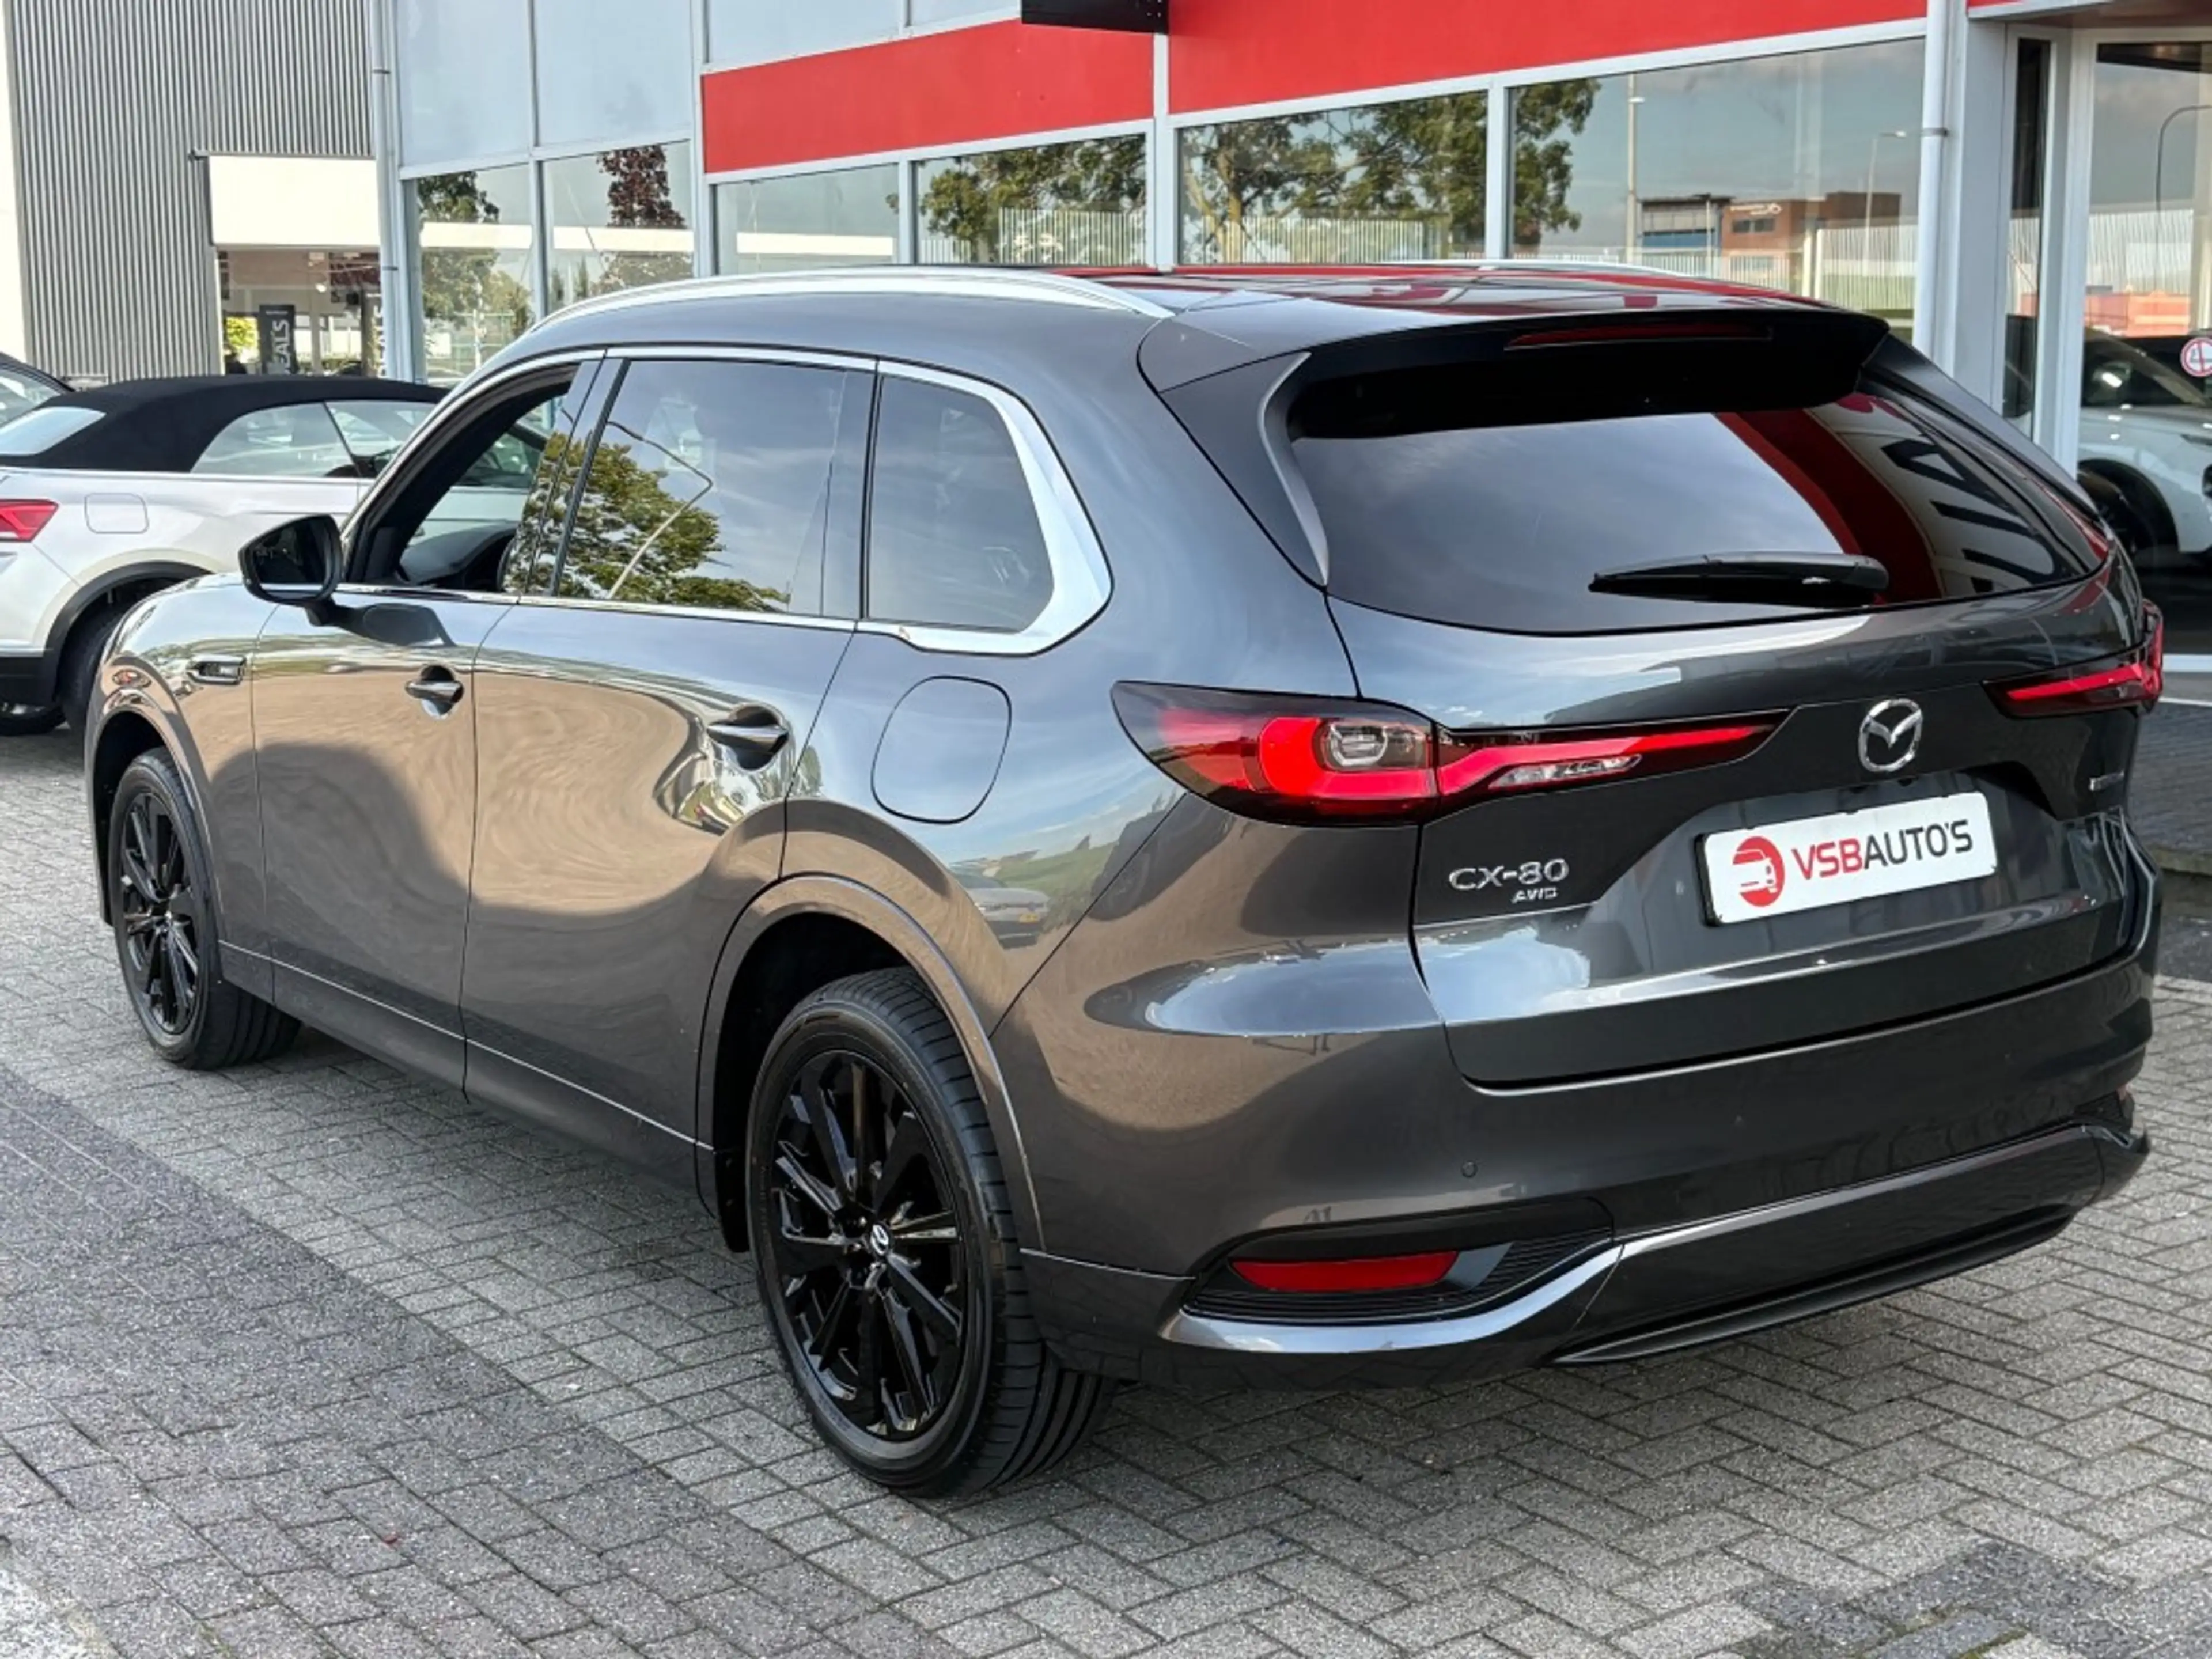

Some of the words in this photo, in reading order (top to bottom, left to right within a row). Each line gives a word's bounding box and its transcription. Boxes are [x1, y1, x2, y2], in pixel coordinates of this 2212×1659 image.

[272, 319, 289, 374] EALS
[1791, 819, 1973, 880] VSBAUTO'S
[1449, 858, 1570, 890] CX-80
[1510, 887, 1558, 904] AWD
